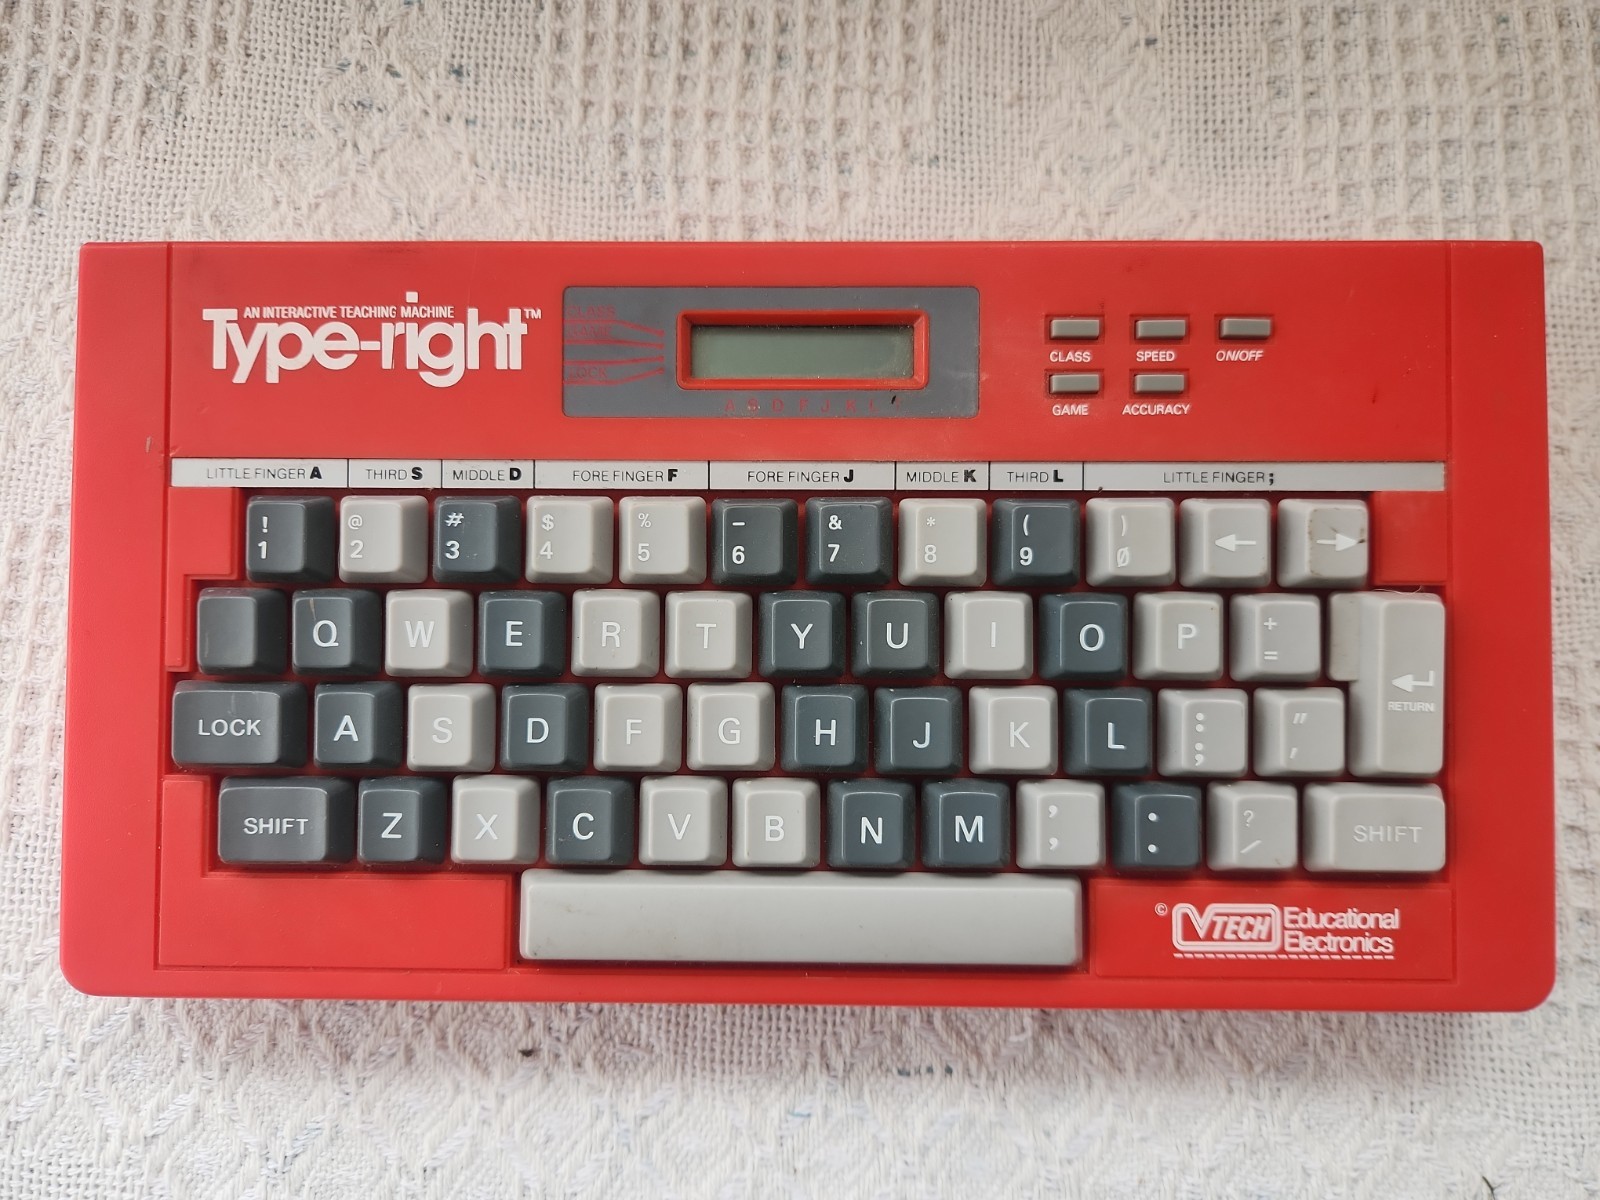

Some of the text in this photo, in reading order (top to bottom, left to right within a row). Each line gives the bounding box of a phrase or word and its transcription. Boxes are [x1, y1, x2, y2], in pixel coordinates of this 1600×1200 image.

[243, 306, 455, 318] AN INTERACTIVE TEACHING MACHINE
[1050, 351, 1091, 362] CLASS
[1136, 351, 1175, 362] SPEED
[1215, 350, 1264, 362] ON/OFF
[725, 399, 736, 412] A
[772, 398, 784, 412] D
[1052, 404, 1089, 416] GAME
[1122, 403, 1190, 416] ACCURACY
[206, 466, 323, 480] LITTLE FINGER A
[366, 466, 423, 481] THIRD S
[452, 467, 522, 481] MIDDLE D
[572, 468, 678, 482] FORE FINGER F
[747, 469, 854, 483] FORE FINGER J
[906, 469, 977, 483] MIDDLE K
[1006, 469, 1064, 483] THIRD L
[1163, 471, 1275, 485] LITTLE FINGER ;
[262, 516, 268, 533] !
[347, 514, 363, 530] @
[444, 512, 464, 527] #
[541, 513, 555, 531] $
[638, 513, 652, 528] %
[828, 514, 843, 530] &
[1022, 514, 1030, 536] (
[257, 540, 267, 559] 1
[350, 539, 363, 559] 2
[445, 540, 460, 560] 3
[539, 541, 554, 560] 4
[637, 543, 650, 562] 5
[731, 545, 746, 564] 6
[827, 543, 841, 562] 7
[924, 544, 937, 563] 8
[1019, 546, 1033, 566] 9
[312, 619, 339, 648] Q
[404, 620, 435, 648] W
[505, 620, 523, 647] E
[601, 621, 621, 648] R
[695, 623, 717, 649] T
[790, 622, 814, 650] Y
[885, 622, 909, 650] U
[1177, 623, 1197, 650] P
[1387, 701, 1435, 712] RETURN
[198, 718, 262, 737] LOCK
[333, 714, 360, 742] A
[431, 717, 453, 744] S
[526, 717, 549, 744] D
[625, 718, 642, 745] F
[717, 717, 742, 745] G
[815, 718, 837, 746] H
[912, 721, 931, 750] J
[1010, 721, 1030, 748] K
[1107, 722, 1126, 750] L
[242, 817, 309, 835] SHIFT
[381, 812, 403, 839] Z
[474, 813, 498, 841] X
[572, 812, 595, 841] C
[667, 813, 692, 841] V
[1243, 809, 1254, 828] ?
[765, 815, 785, 842] B
[860, 816, 883, 844] N
[954, 815, 984, 843] M
[1352, 824, 1423, 844] SHIFT
[1283, 906, 1400, 930] Educational
[1284, 930, 1394, 953] Electronics
